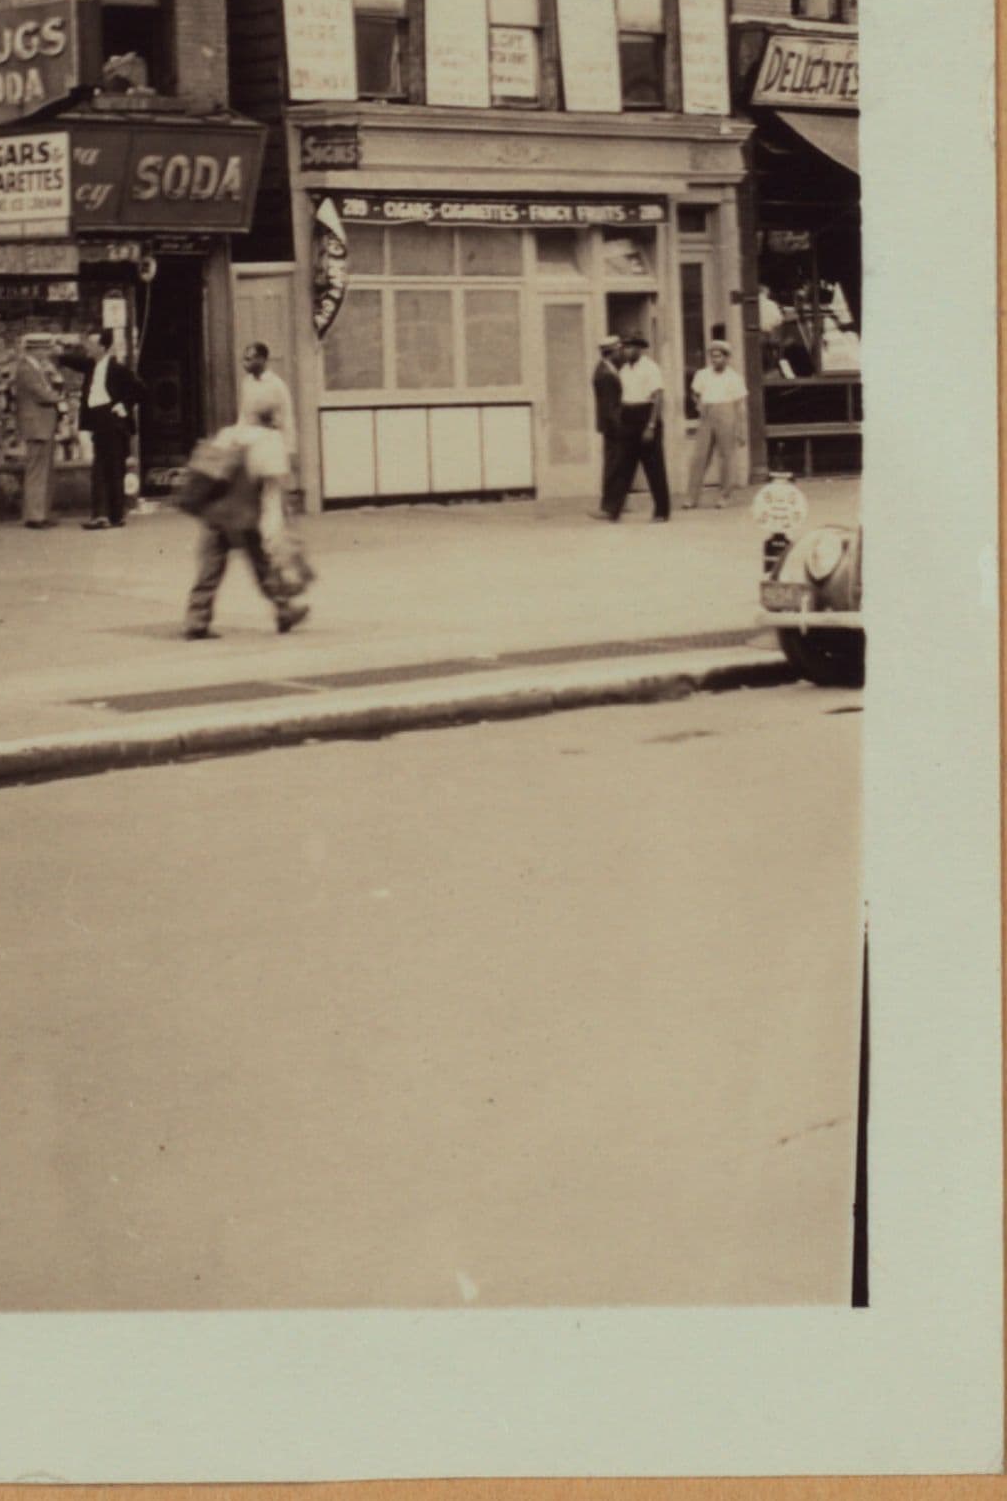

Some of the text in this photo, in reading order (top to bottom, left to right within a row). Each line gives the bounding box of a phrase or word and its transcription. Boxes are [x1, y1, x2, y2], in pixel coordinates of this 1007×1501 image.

[132, 154, 243, 201] SODA
[384, 201, 434, 220] CIGARS
[441, 203, 519, 221] CIGARETTES
